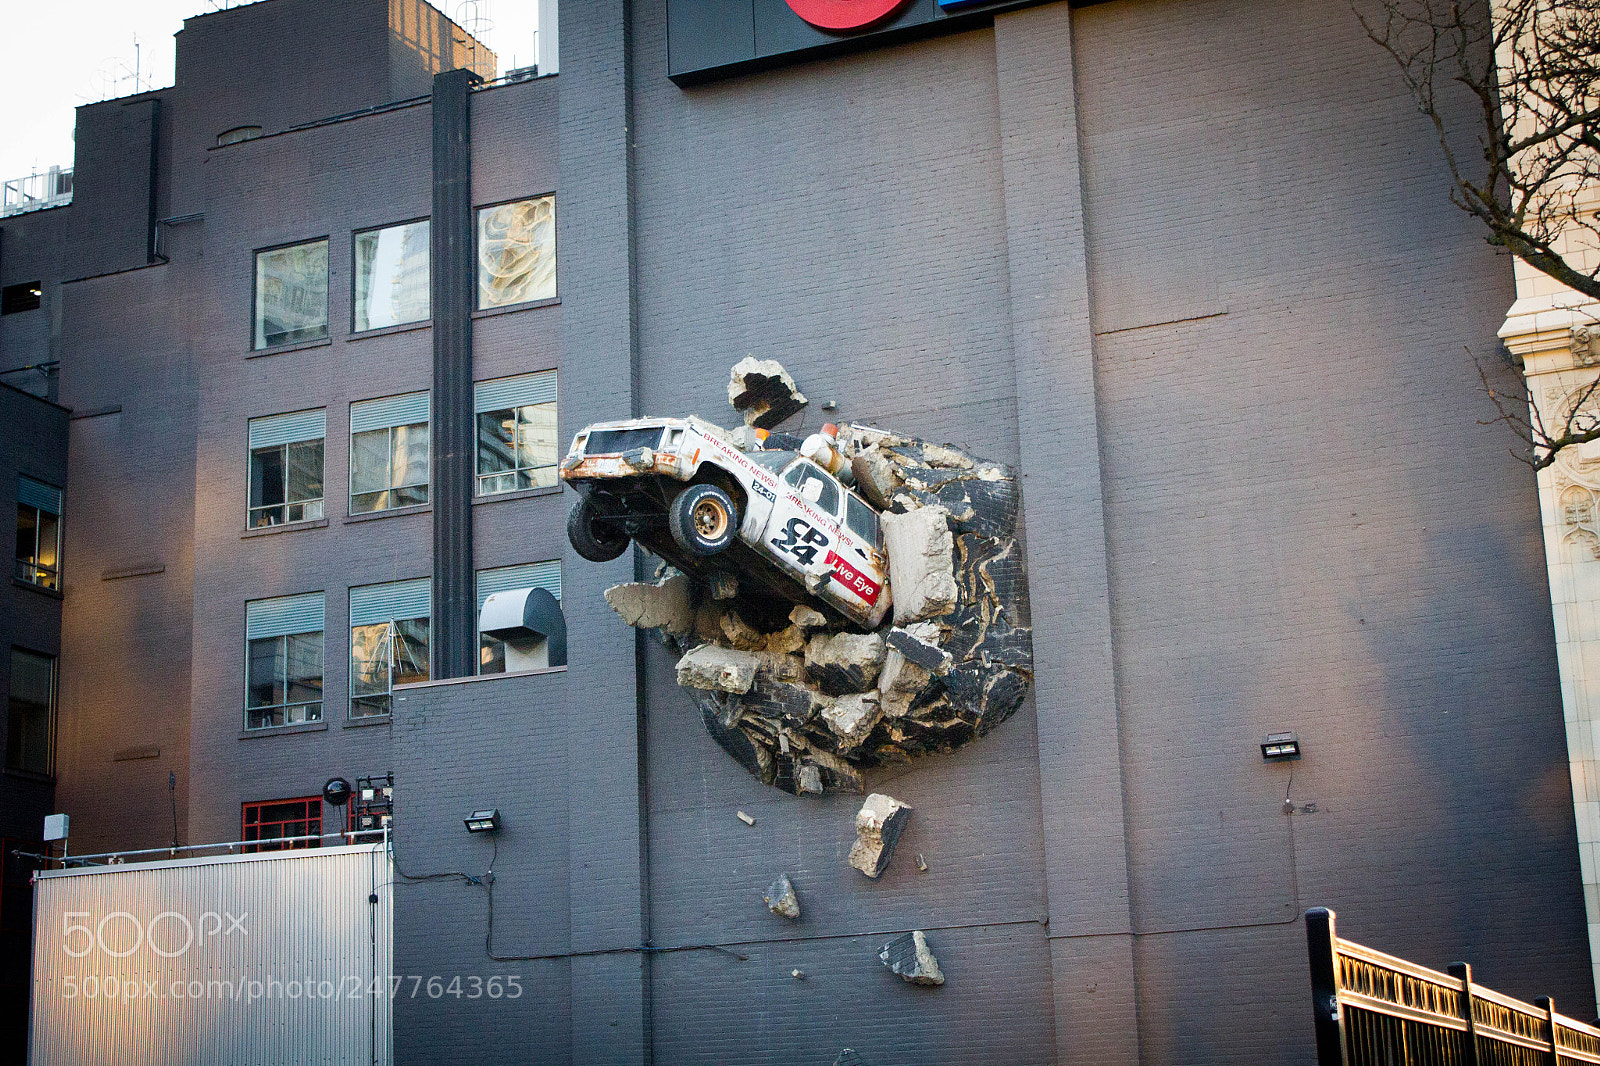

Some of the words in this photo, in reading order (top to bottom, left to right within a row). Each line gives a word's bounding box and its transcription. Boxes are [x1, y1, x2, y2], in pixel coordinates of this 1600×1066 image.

[703, 432, 748, 468] BREAKING
[752, 483, 776, 501] 24-01
[831, 558, 854, 581] Live
[852, 576, 875, 596] Eye
